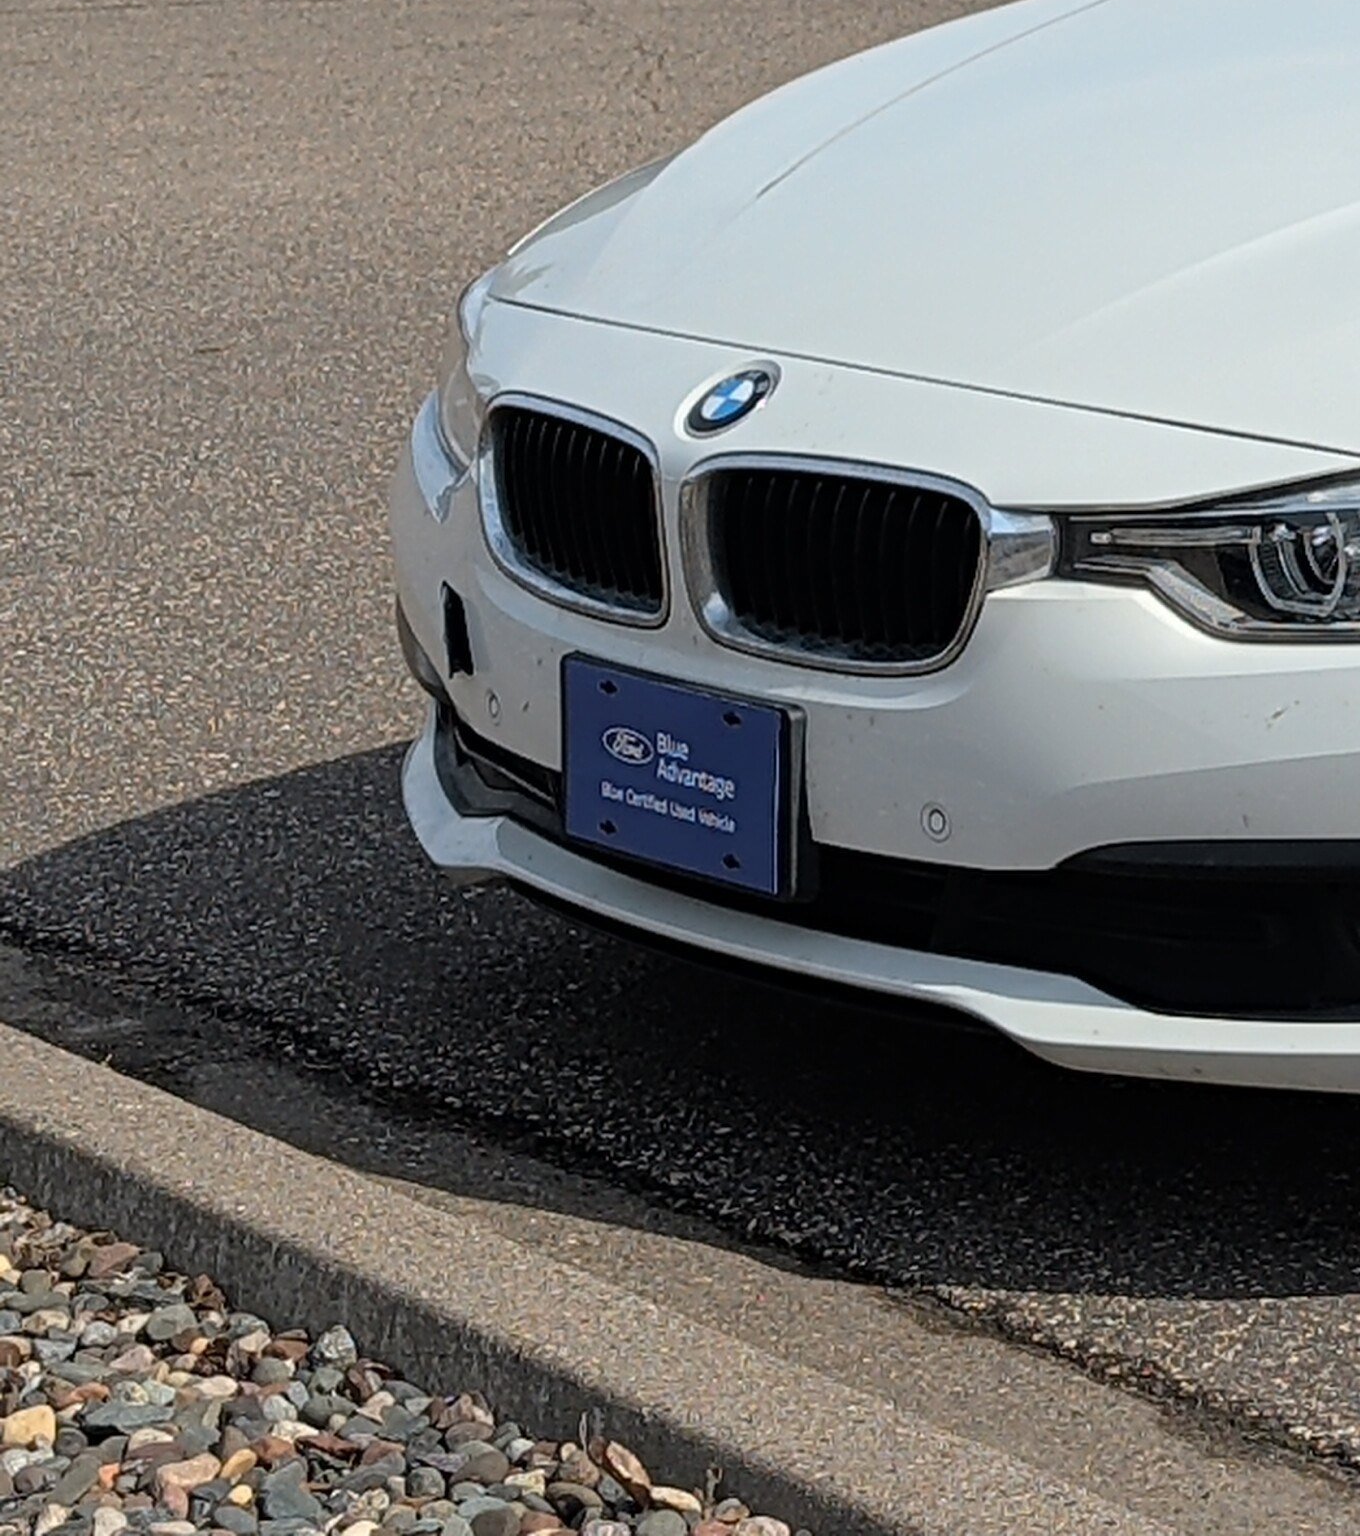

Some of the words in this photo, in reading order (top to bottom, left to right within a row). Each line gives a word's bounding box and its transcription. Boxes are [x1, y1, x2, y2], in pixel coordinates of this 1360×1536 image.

[656, 731, 690, 762] Blue
[656, 757, 736, 801] Advantage
[625, 787, 669, 815] Certified
[669, 800, 697, 823] Used
[697, 806, 737, 834] Vehicle
